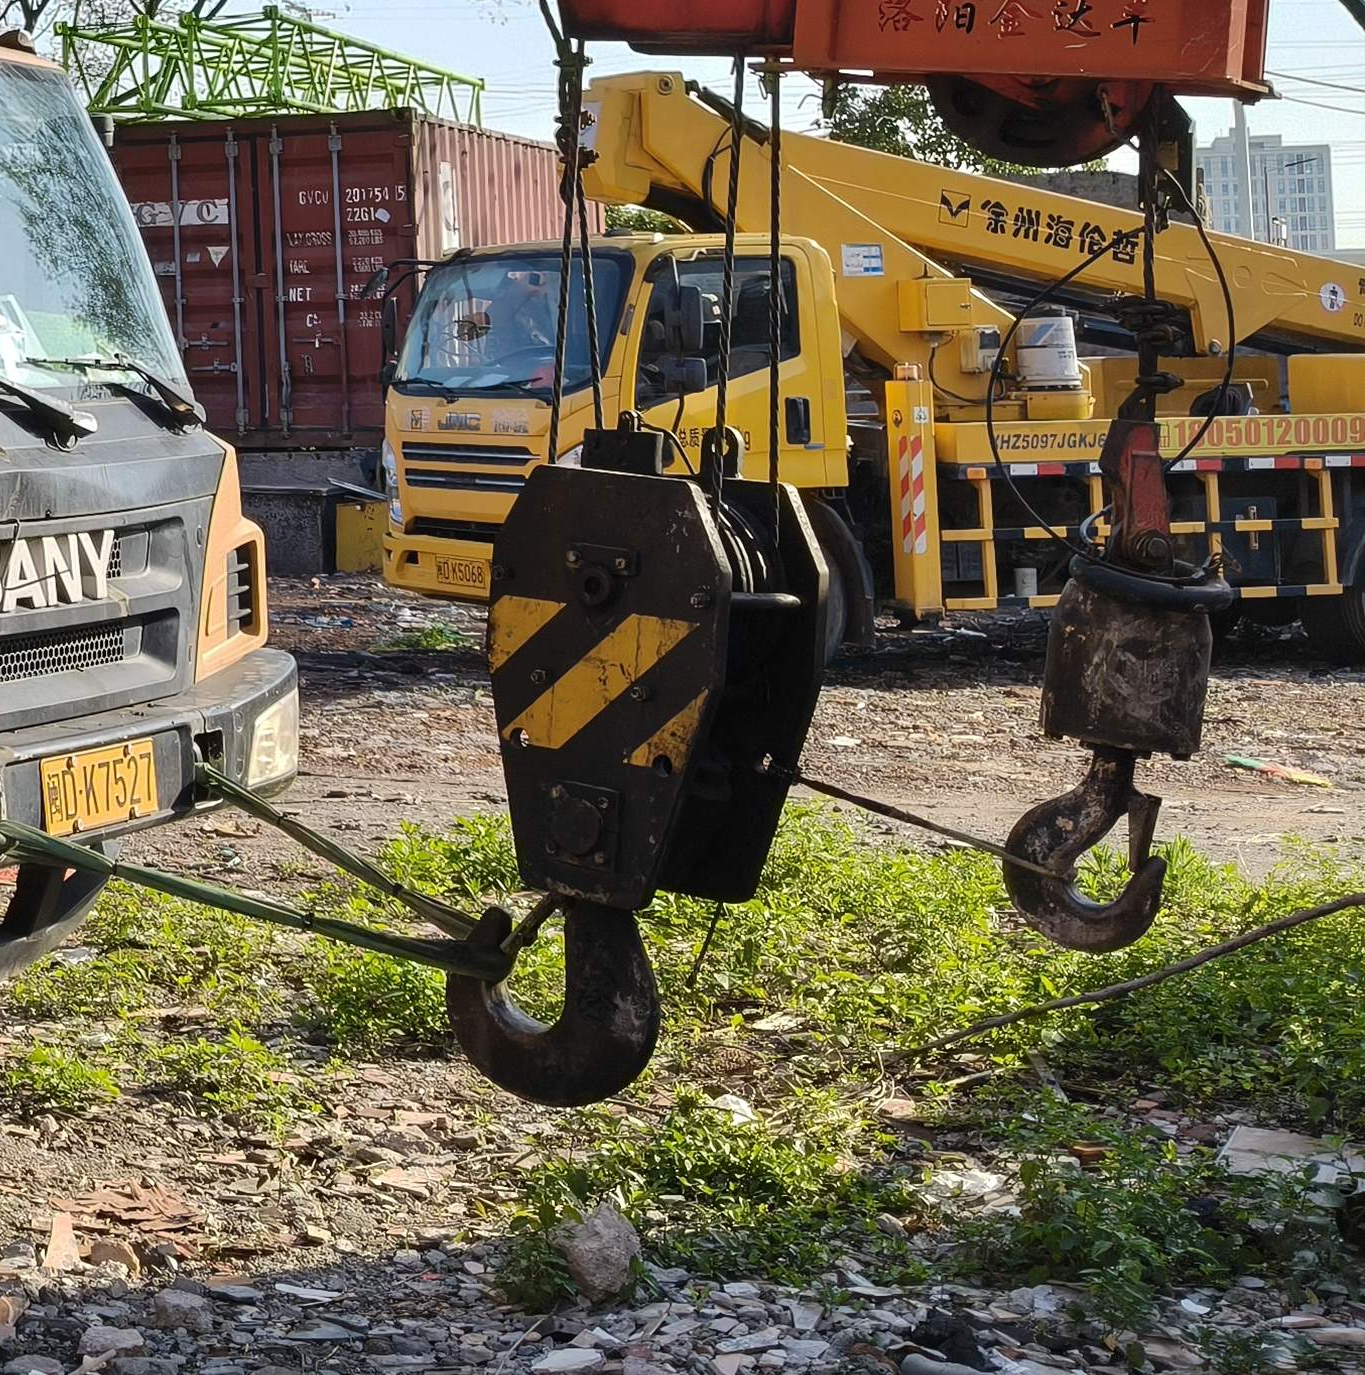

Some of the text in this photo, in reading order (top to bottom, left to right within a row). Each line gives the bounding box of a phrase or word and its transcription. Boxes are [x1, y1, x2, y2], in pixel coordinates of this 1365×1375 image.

[298, 190, 329, 205] GVCU
[346, 207, 375, 221] 22G1
[981, 199, 1140, 265] 徐州海伦哲
[289, 288, 312, 302] NET
[437, 412, 481, 431] JMC
